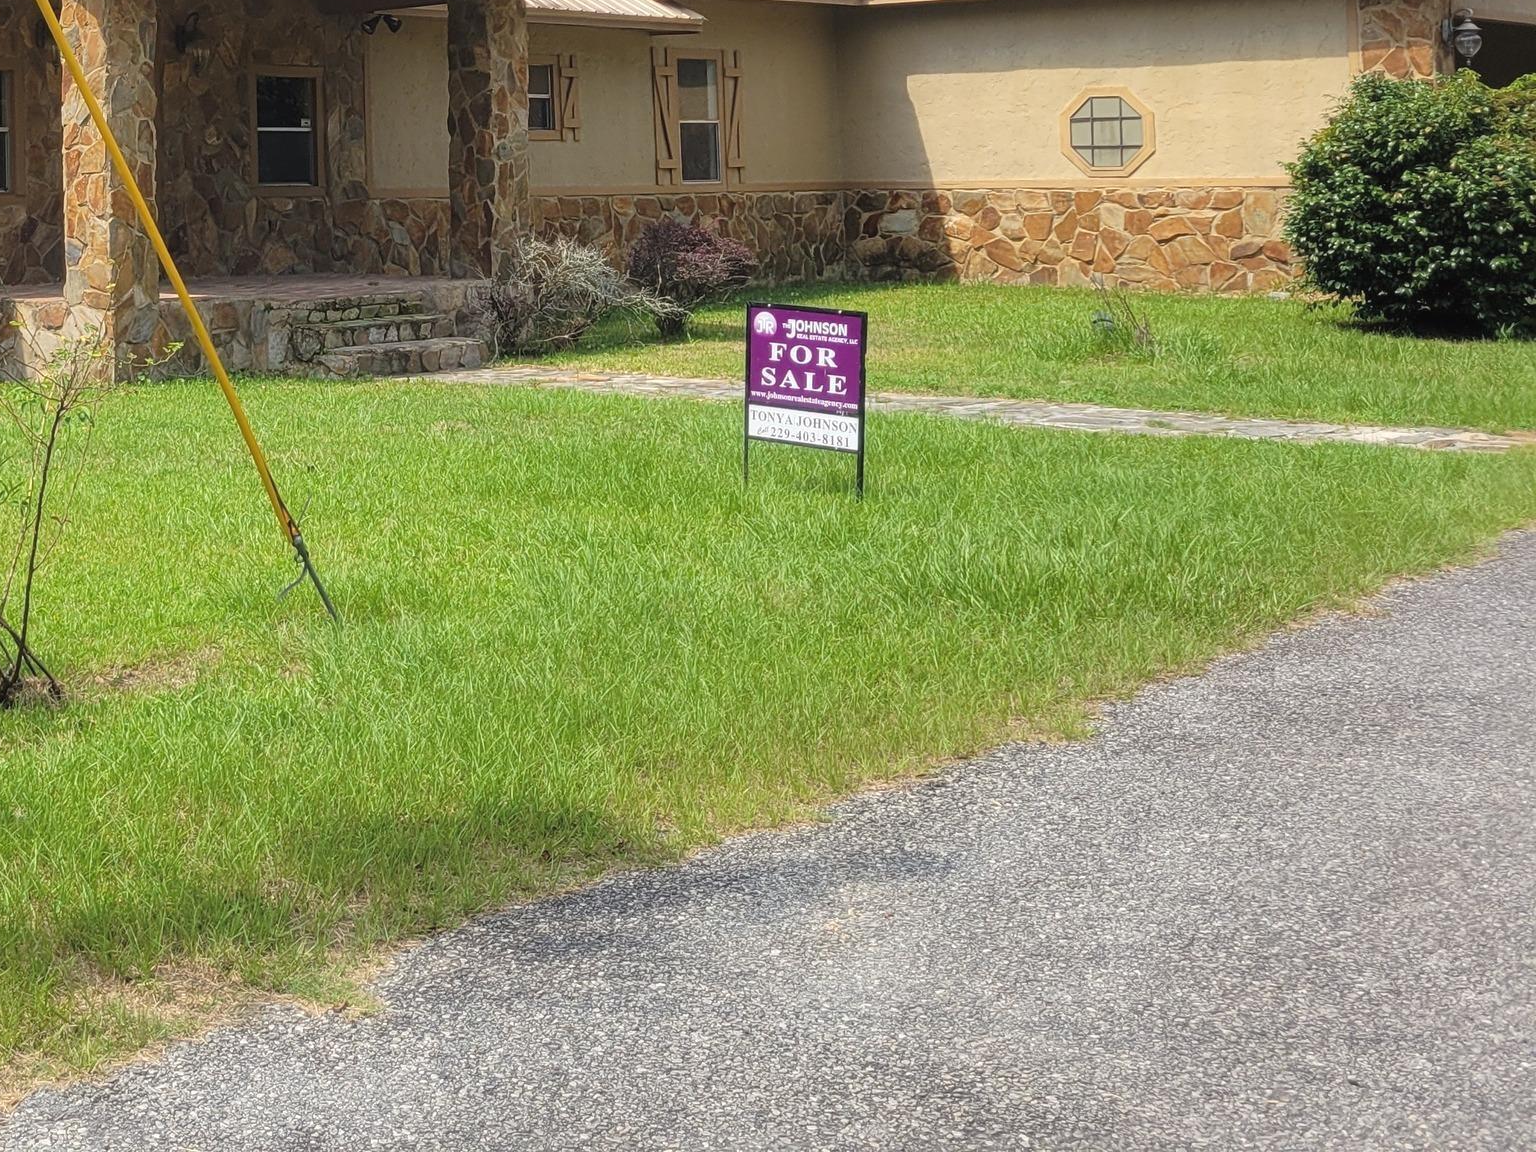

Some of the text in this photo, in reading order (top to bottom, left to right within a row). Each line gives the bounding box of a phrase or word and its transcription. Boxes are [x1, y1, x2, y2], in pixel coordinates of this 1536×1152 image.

[786, 318, 848, 338] JOHNSON
[809, 334, 827, 342] ESTATE
[768, 342, 838, 368] FOR
[761, 366, 847, 395] SALE
[750, 390, 858, 409] www.johnsonrealestateagency.com
[750, 409, 857, 433] TONYA JOHNSON
[770, 428, 849, 447] 229-403-8181
